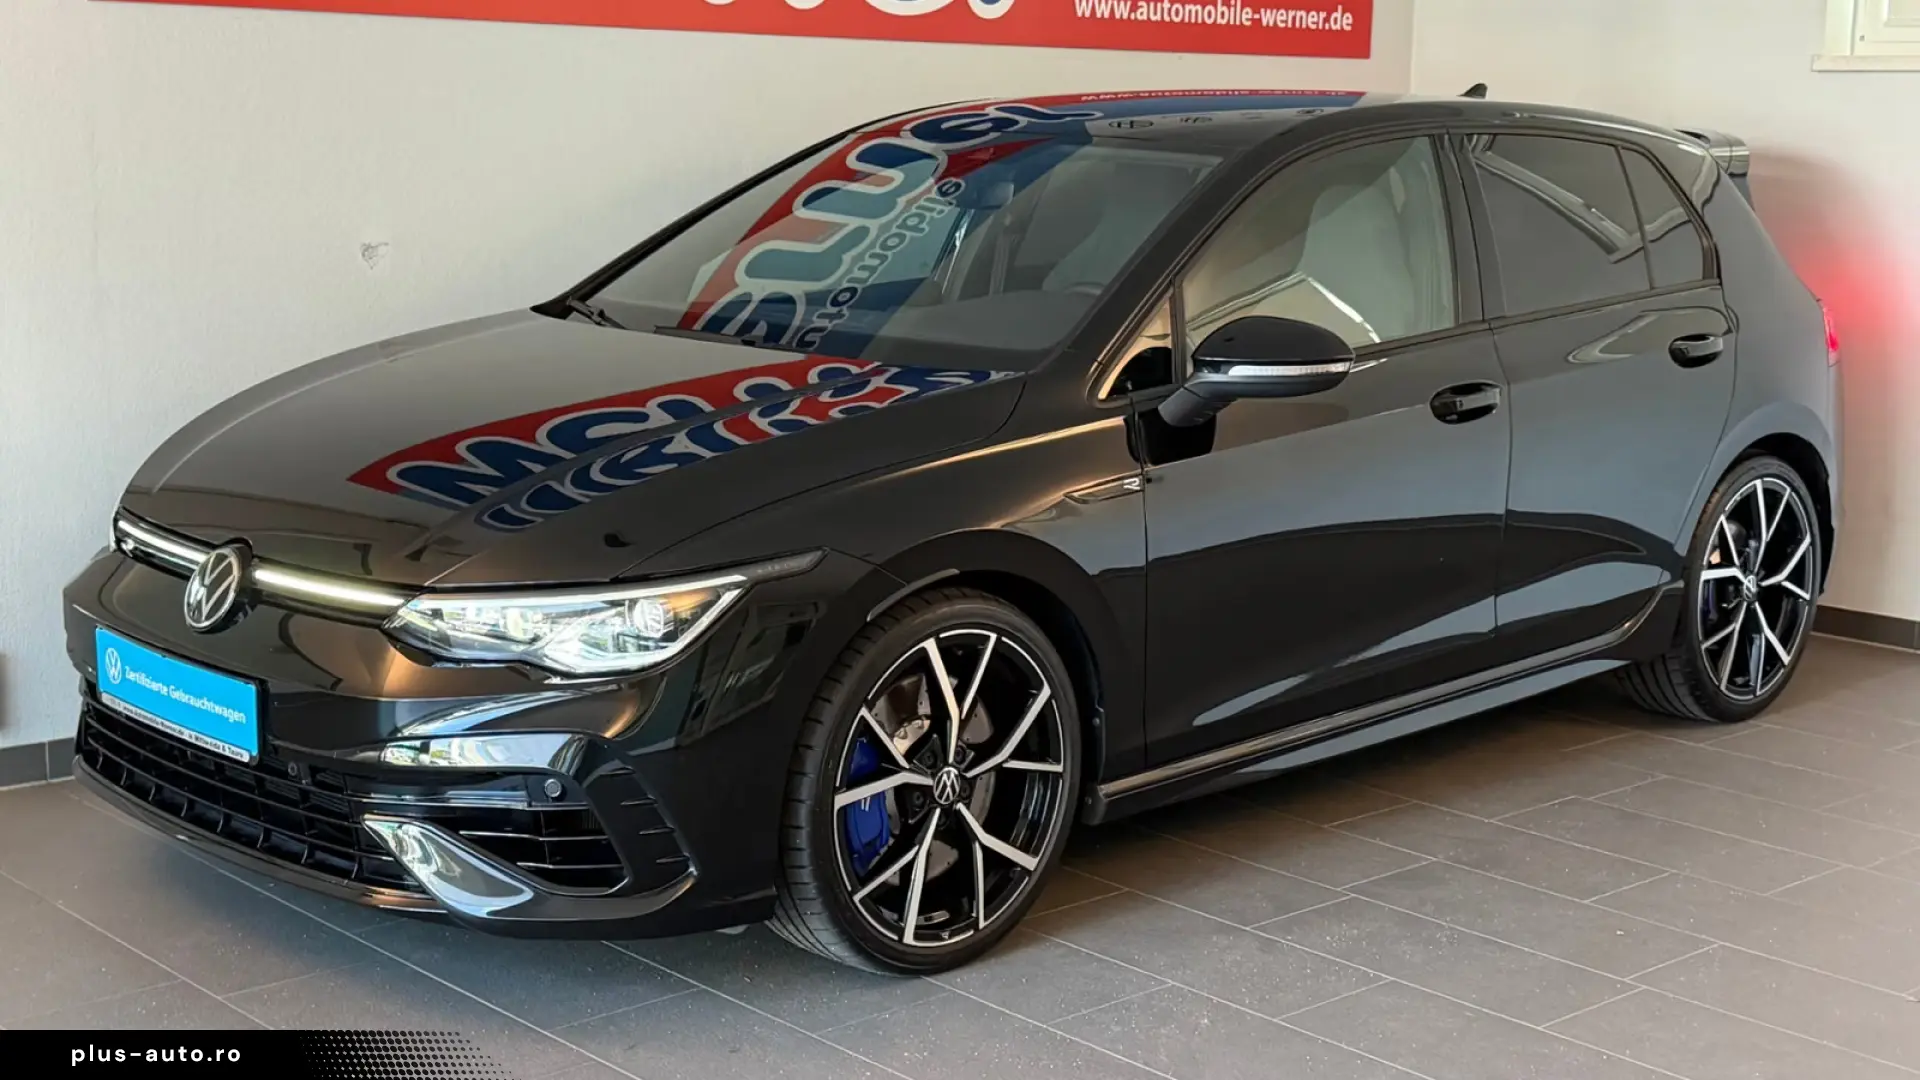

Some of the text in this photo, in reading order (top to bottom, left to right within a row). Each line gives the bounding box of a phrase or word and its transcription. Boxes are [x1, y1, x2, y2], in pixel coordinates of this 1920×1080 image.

[1075, 0, 1353, 31] www.automobile-werner.de
[124, 665, 247, 725] Zertifizierte Gebrauchtwagen
